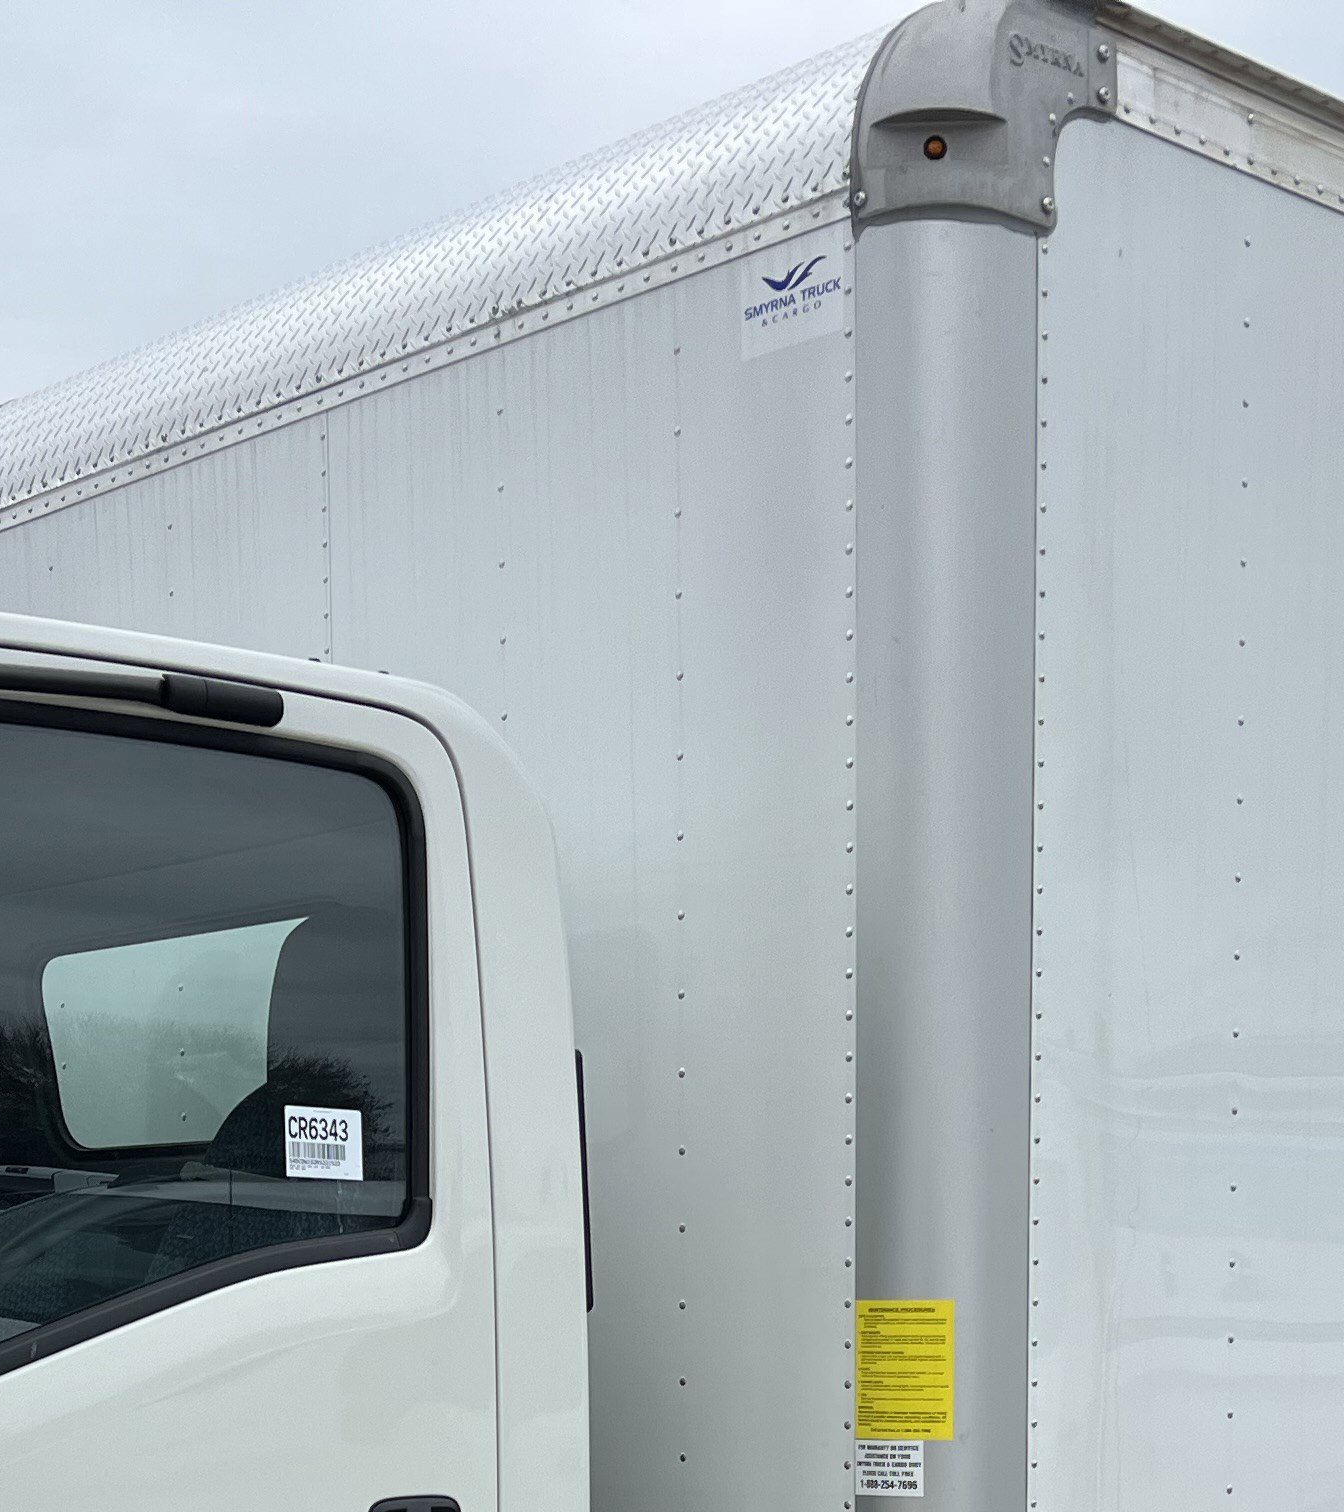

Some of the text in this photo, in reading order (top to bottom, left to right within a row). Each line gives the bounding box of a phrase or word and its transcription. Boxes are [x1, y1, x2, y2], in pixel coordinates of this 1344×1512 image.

[744, 276, 842, 321] SMYRNA TRUCK
[771, 300, 822, 324] CARGO
[288, 1115, 349, 1142] CR6343
